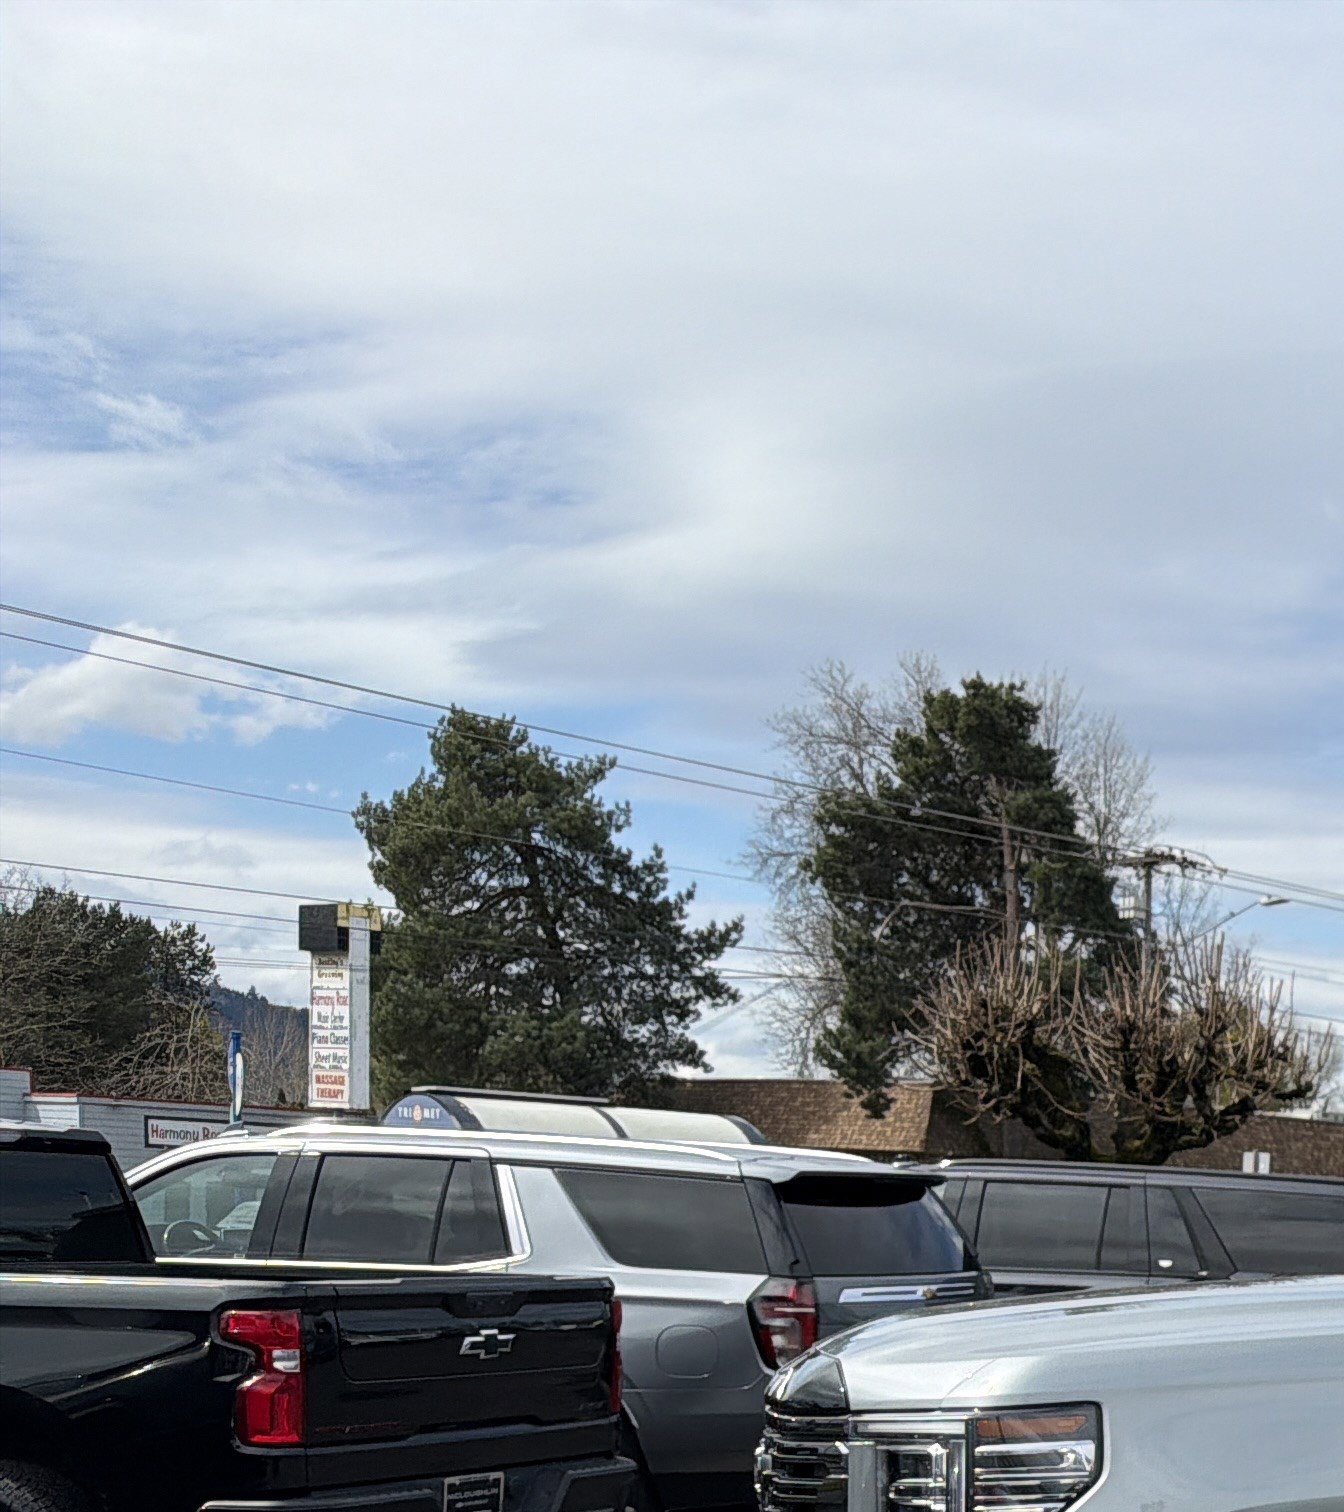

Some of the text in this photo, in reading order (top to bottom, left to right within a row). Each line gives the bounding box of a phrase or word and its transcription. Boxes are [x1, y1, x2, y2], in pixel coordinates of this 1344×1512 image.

[315, 1074, 345, 1086] MASSAGE
[317, 1087, 345, 1099] THERAPY
[151, 1123, 199, 1142] Harmony
